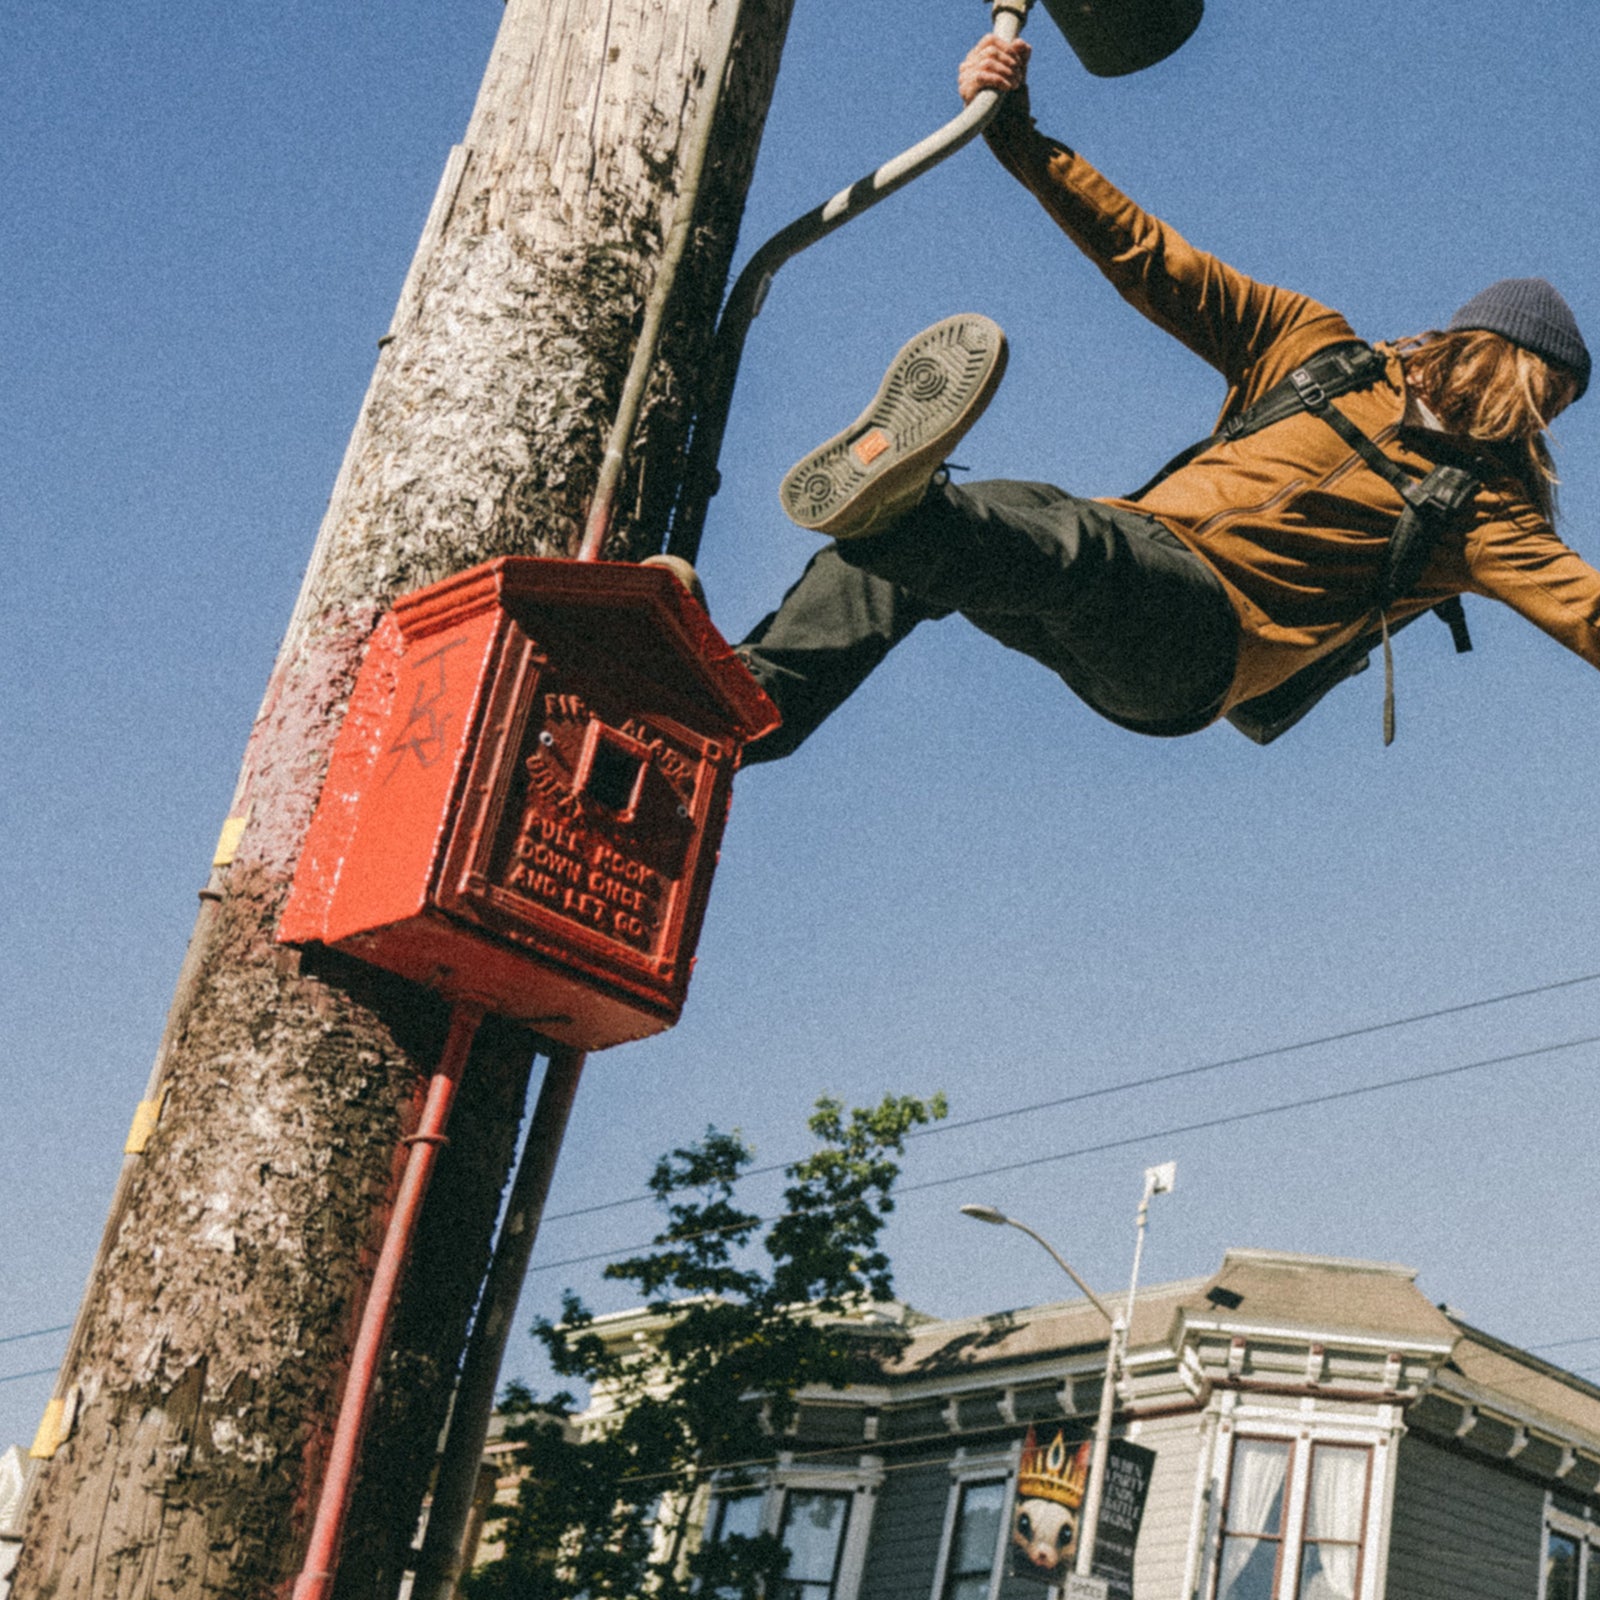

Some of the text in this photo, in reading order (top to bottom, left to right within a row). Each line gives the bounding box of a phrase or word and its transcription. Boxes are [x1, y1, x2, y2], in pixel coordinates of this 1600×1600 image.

[517, 833, 647, 911] DOWN ONCE
[523, 806, 655, 886] PULL HOOK
[509, 863, 643, 937] AND LET GO
[1111, 1470, 1145, 1493] PARTY
